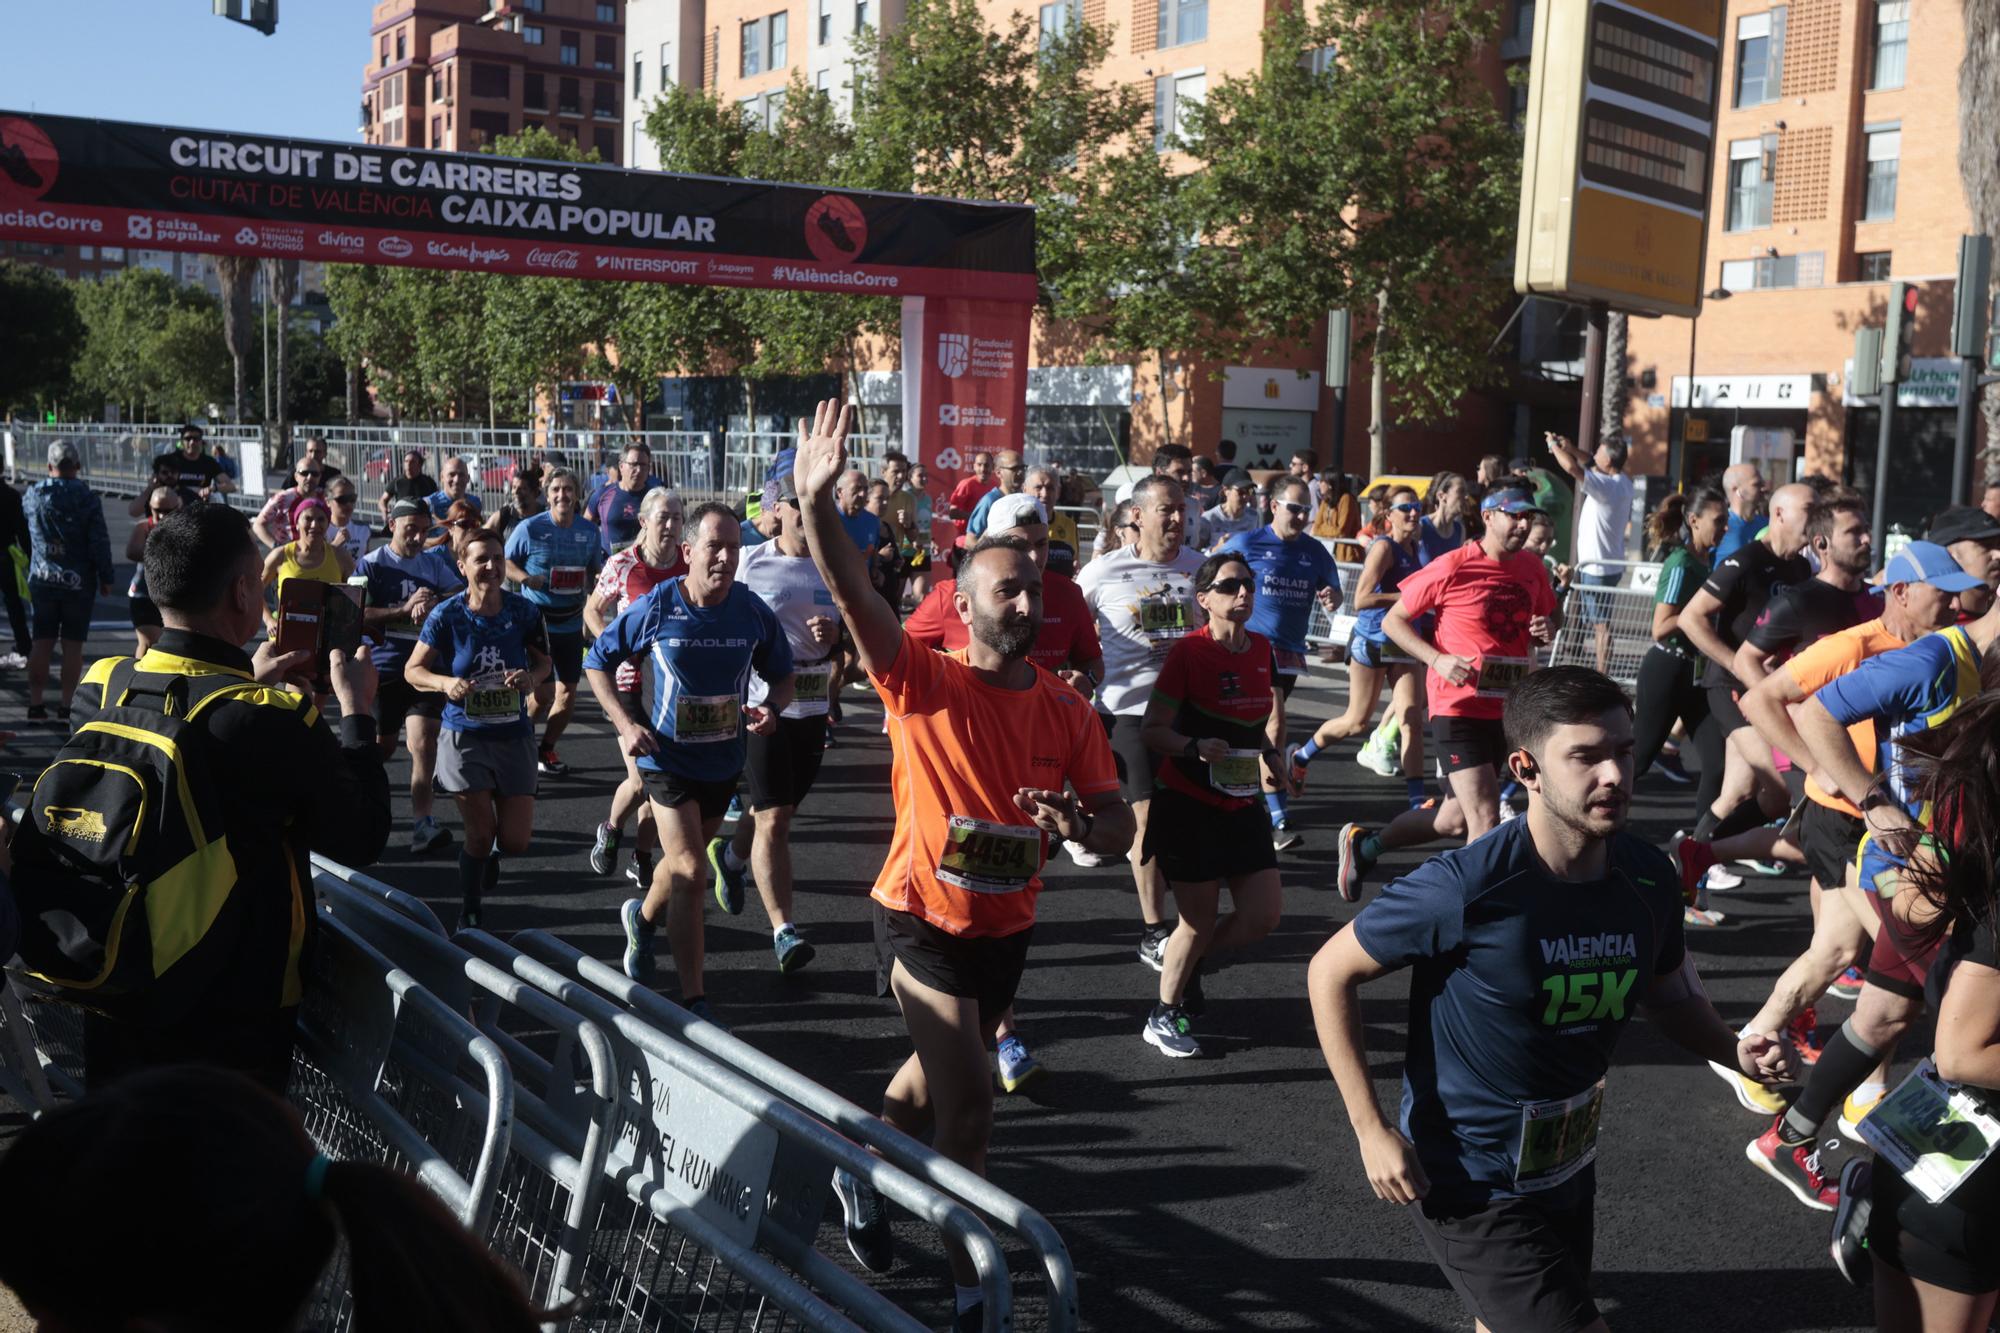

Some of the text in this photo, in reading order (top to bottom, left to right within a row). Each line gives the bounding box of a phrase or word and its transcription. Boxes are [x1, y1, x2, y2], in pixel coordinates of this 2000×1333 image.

[170, 137, 582, 201] CIRCUIT DE CARRERES
[170, 175, 434, 219] CIUTAT DE VALÈNCIA
[157, 218, 198, 231] caixa
[441, 195, 716, 242] CAIXA POPULAR
[156, 229, 221, 243] popular
[261, 234, 304, 243] TRINIDAD
[318, 230, 364, 248] divina
[260, 242, 304, 251] ALFONSO
[610, 256, 699, 275] INTERSPORT
[772, 265, 898, 287] #ValènciaCorre
[972, 359, 1014, 369] Municipal
[961, 406, 991, 416] caixa
[961, 415, 1006, 426] popular
[668, 638, 747, 648] STADLER
[1539, 932, 1638, 965] VALENCIA
